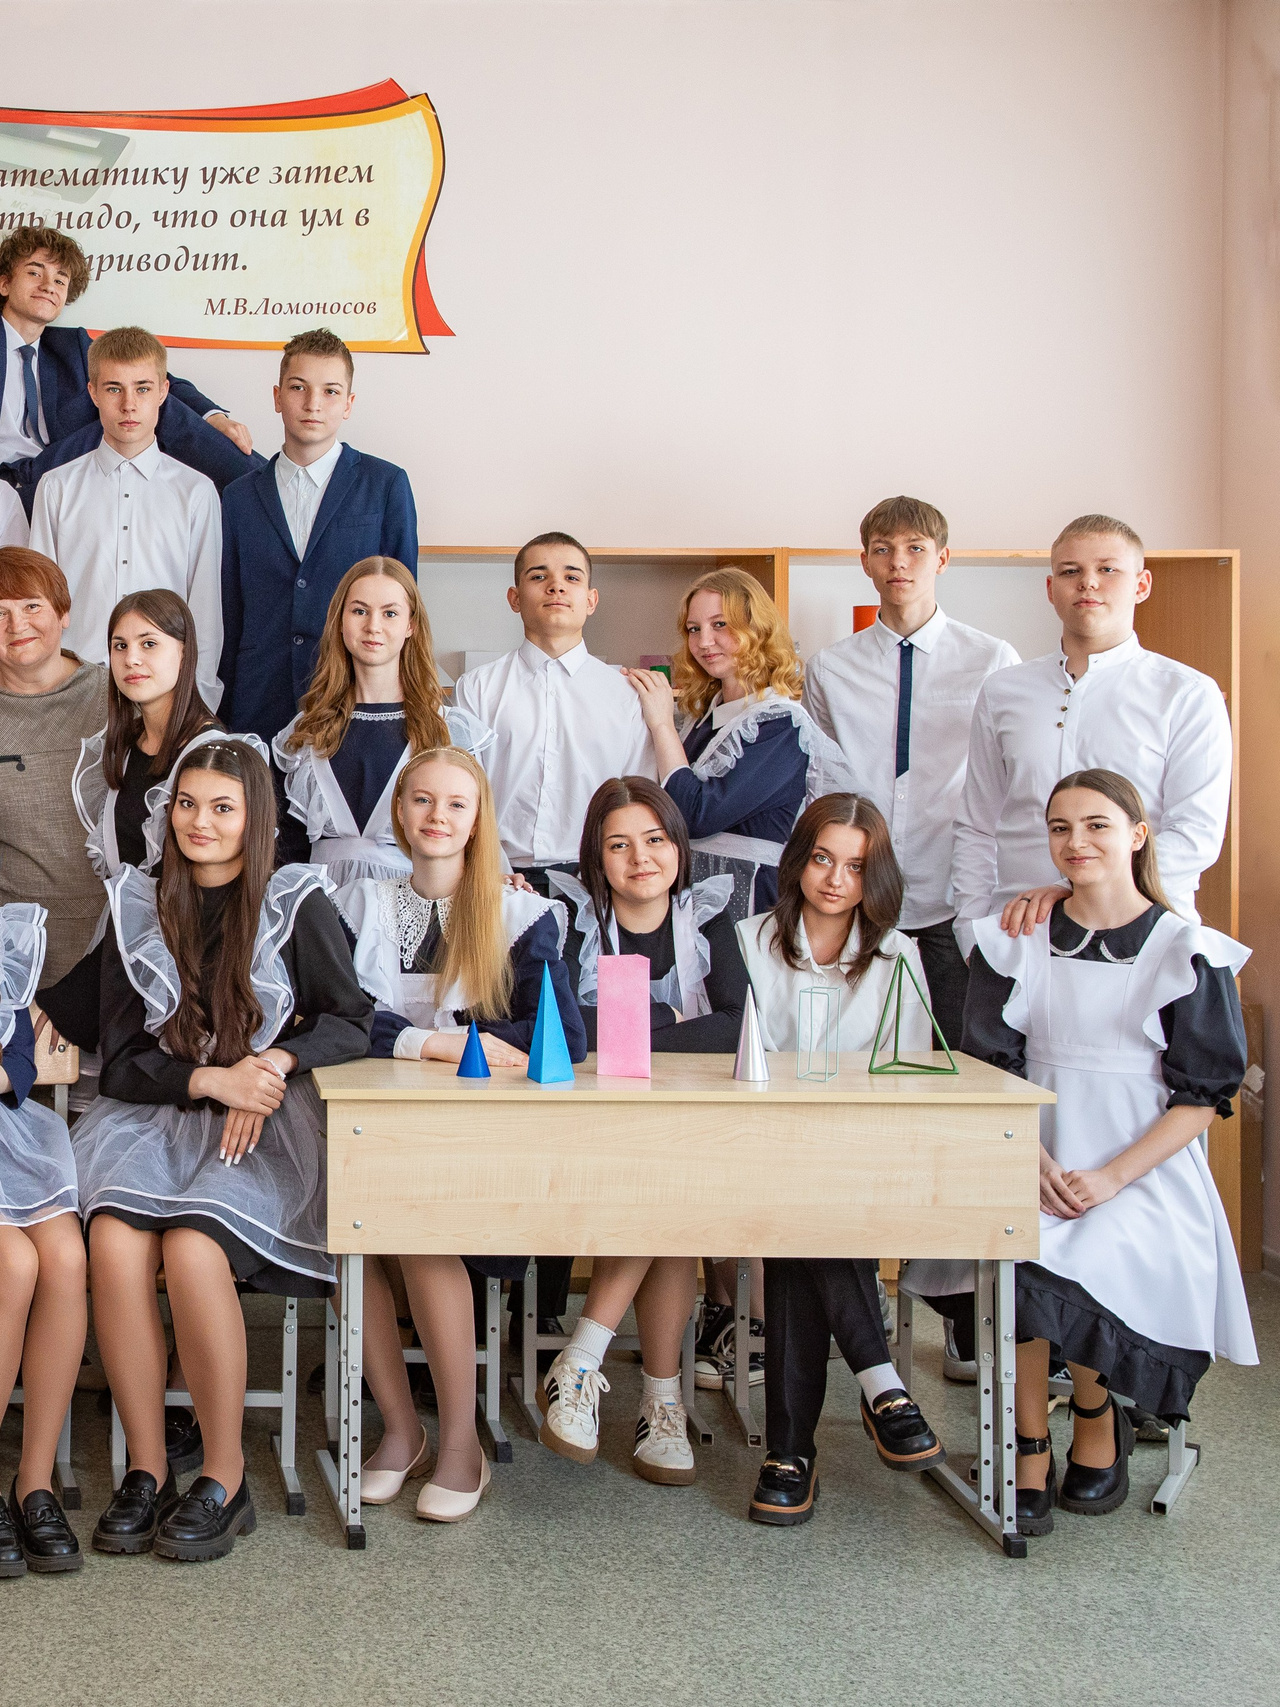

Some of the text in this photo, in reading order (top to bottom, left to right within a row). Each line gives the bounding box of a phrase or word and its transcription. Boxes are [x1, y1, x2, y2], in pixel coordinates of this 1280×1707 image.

[199, 165, 260, 195] уже
[269, 163, 375, 185] затем
[54, 203, 141, 234] надо,
[152, 208, 218, 229] что
[229, 208, 288, 228] она
[299, 206, 344, 236] ум
[354, 206, 370, 227] в
[204, 297, 377, 316] М.В.Ломоносов
